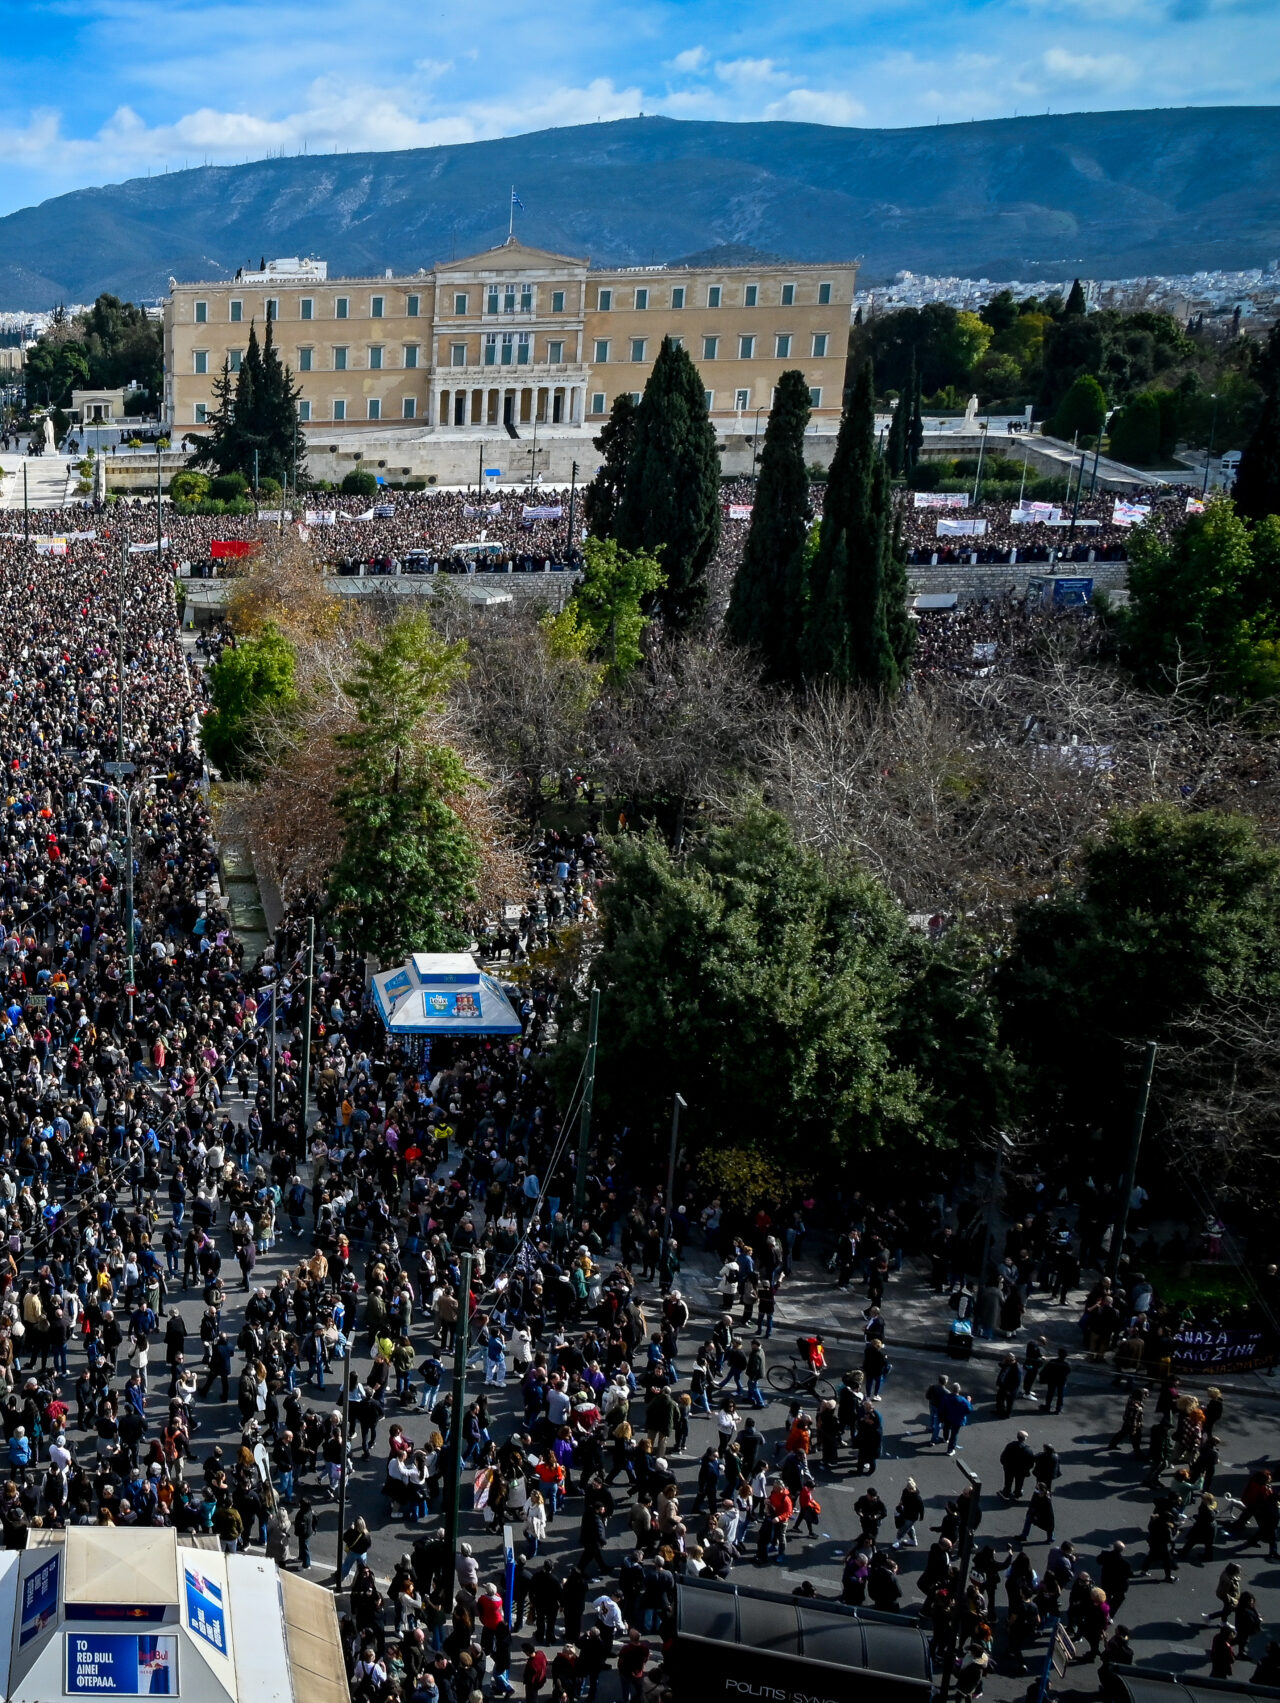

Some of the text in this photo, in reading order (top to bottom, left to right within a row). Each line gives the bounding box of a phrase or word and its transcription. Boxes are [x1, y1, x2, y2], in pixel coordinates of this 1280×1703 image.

[76, 1652, 114, 1663] RED BULL
[76, 1664, 98, 1675] ΔΙΝΕΙ
[76, 1675, 117, 1687] ΦΤΕΡΑΑΑ.
[725, 1679, 786, 1700] POLITIS
